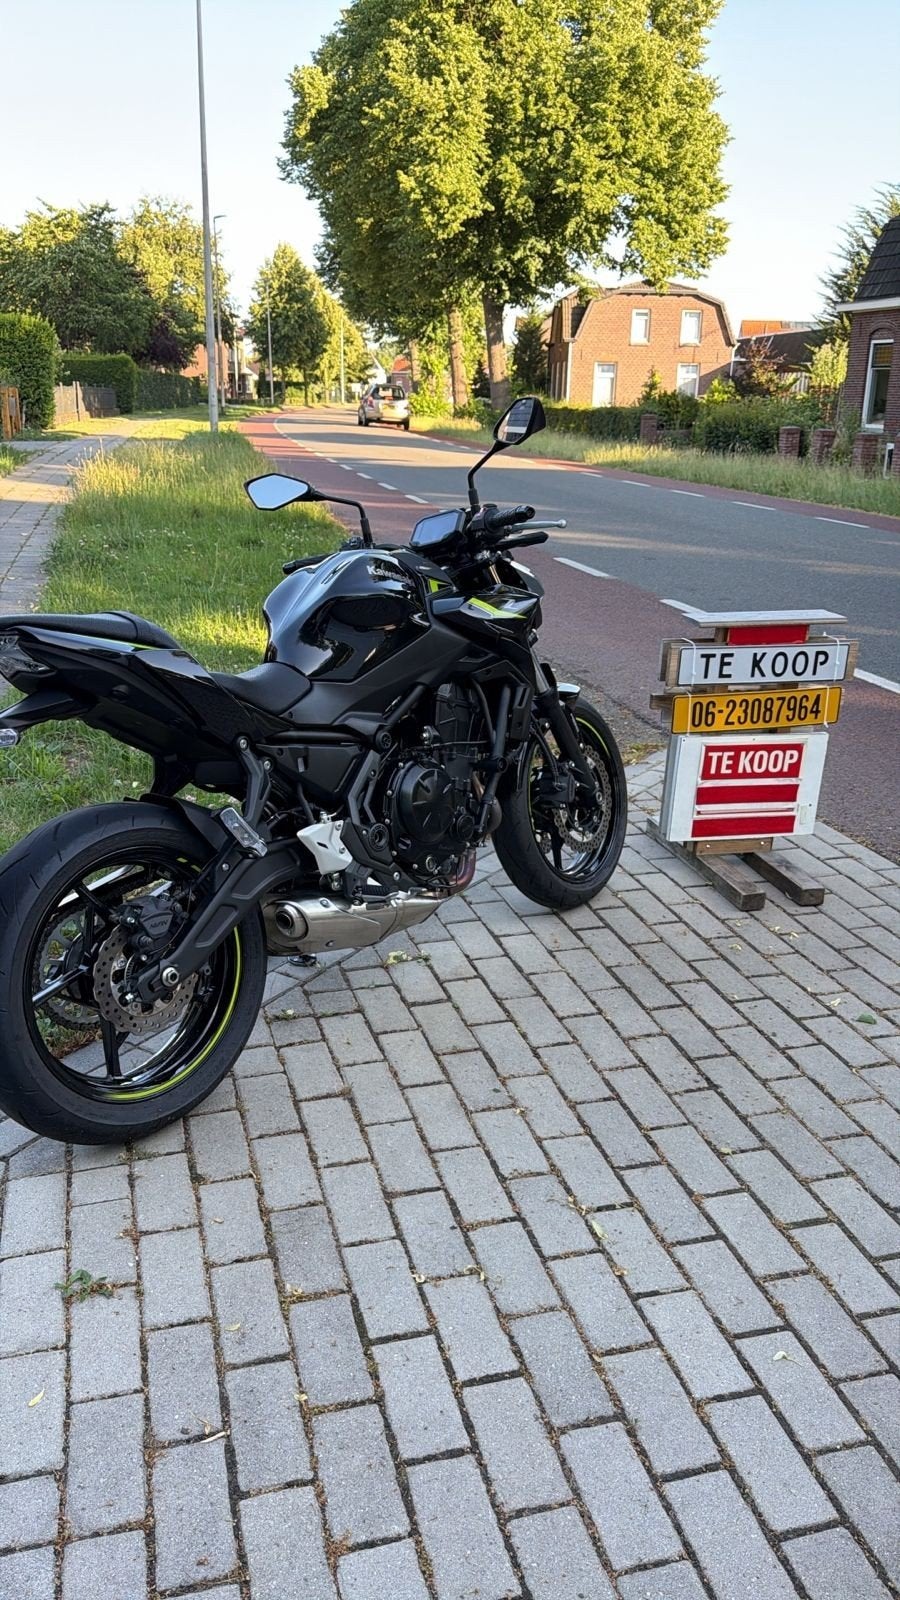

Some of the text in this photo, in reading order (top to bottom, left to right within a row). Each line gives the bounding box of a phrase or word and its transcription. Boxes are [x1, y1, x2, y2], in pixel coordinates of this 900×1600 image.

[700, 650, 829, 679] TE KOOP
[691, 693, 822, 728] 06-23087964
[708, 749, 799, 775] TE KOOP
